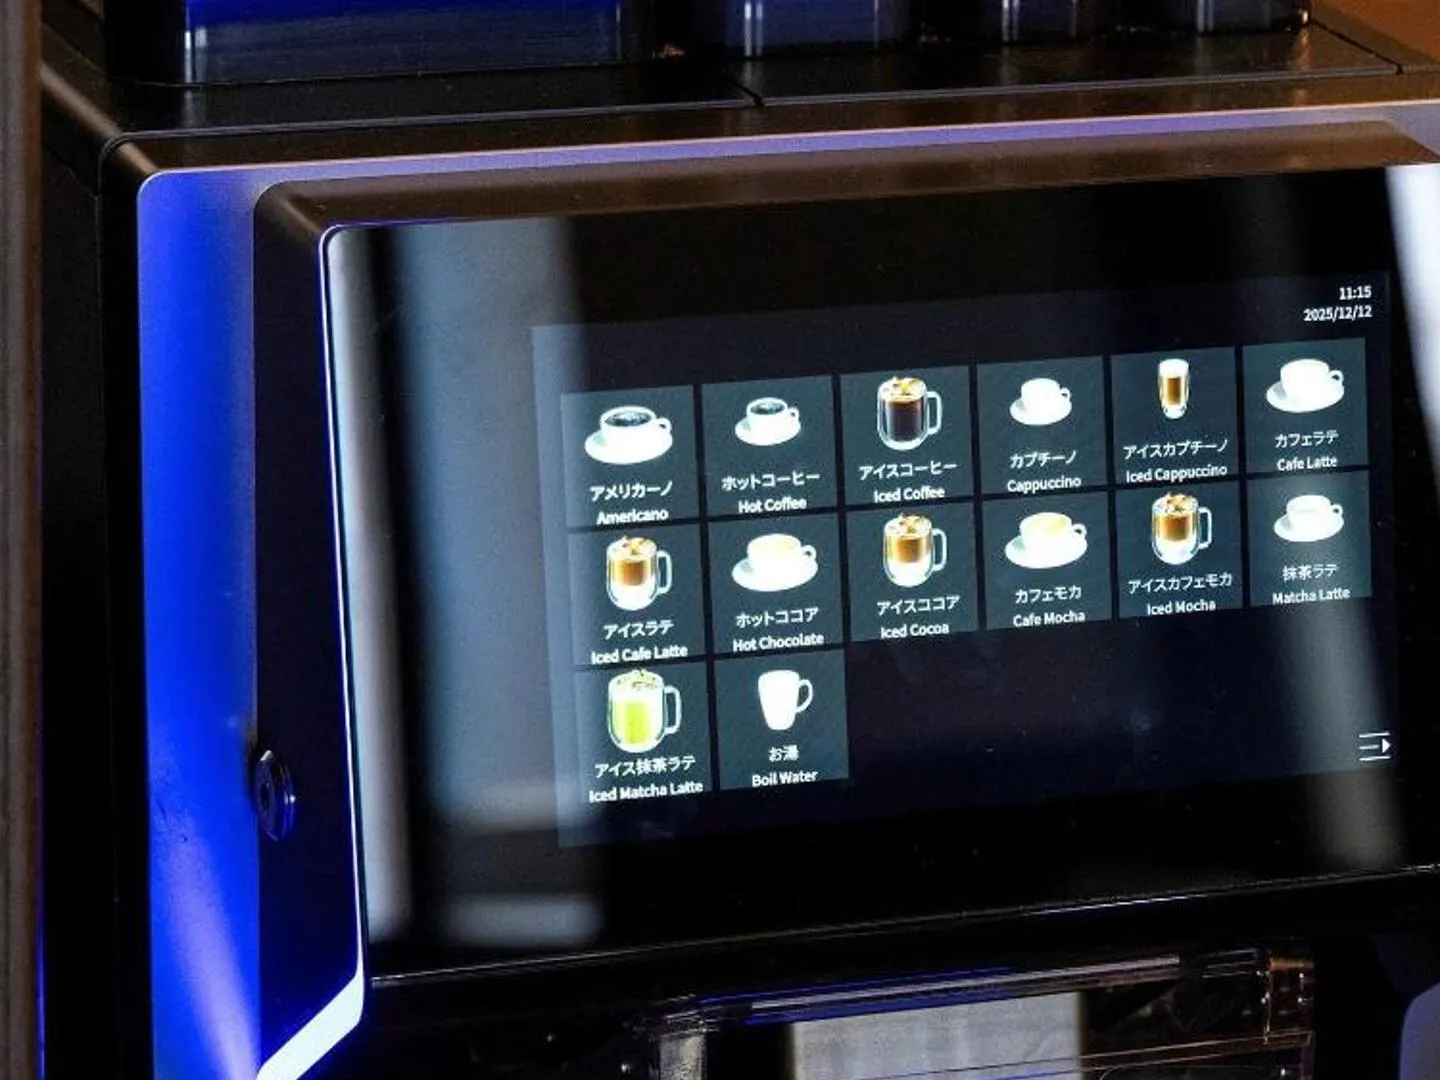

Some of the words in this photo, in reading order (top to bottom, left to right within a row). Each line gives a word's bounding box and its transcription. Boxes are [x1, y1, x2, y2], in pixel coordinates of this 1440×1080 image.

[1339, 285, 1372, 301] 11:15
[1303, 304, 1373, 322] 2025/12/12
[1274, 429, 1339, 449] カフェラテ
[859, 460, 957, 481] アイスコーヒー
[1126, 468, 1153, 483] Iced
[1153, 463, 1228, 483] Cappuccino
[1276, 456, 1305, 472] Cafe
[1306, 456, 1338, 470] Latte
[589, 480, 673, 502] アメリカーノ
[721, 470, 821, 492] ホットコーヒー
[1006, 475, 1082, 495] Cappuccino
[873, 487, 902, 503] Iced
[902, 484, 946, 501] Coffee
[738, 499, 762, 514] Hot
[763, 495, 807, 512] Coffee
[595, 508, 670, 525] Americano
[1282, 563, 1338, 581] 抹茶ラテ
[1127, 572, 1233, 595] アイスカフェモカ
[1015, 584, 1082, 604] カフェモカ
[1272, 588, 1318, 605] Matcha
[1318, 587, 1351, 601] Latte
[876, 595, 961, 616] アイスココア
[1146, 601, 1173, 616] Iced
[1174, 598, 1216, 613] Mocha
[735, 606, 819, 629] ホットココア
[1012, 612, 1042, 628] Cafe
[1043, 610, 1086, 625] Mocha
[603, 619, 674, 640] アイスラテ
[880, 623, 908, 639] Iced
[909, 623, 950, 637] Cocoa
[732, 638, 758, 652] Hot
[758, 632, 825, 650] Chocolate
[590, 648, 620, 665] Iced
[621, 646, 652, 662] Cafe
[653, 644, 689, 660] Latte
[768, 744, 800, 762] お湯
[594, 755, 696, 779] アイス抹茶ラテ
[751, 771, 778, 788] Boil
[778, 770, 819, 784] Water
[588, 787, 618, 803] Iced
[619, 783, 668, 800] Matcha
[669, 780, 704, 796] Latte
